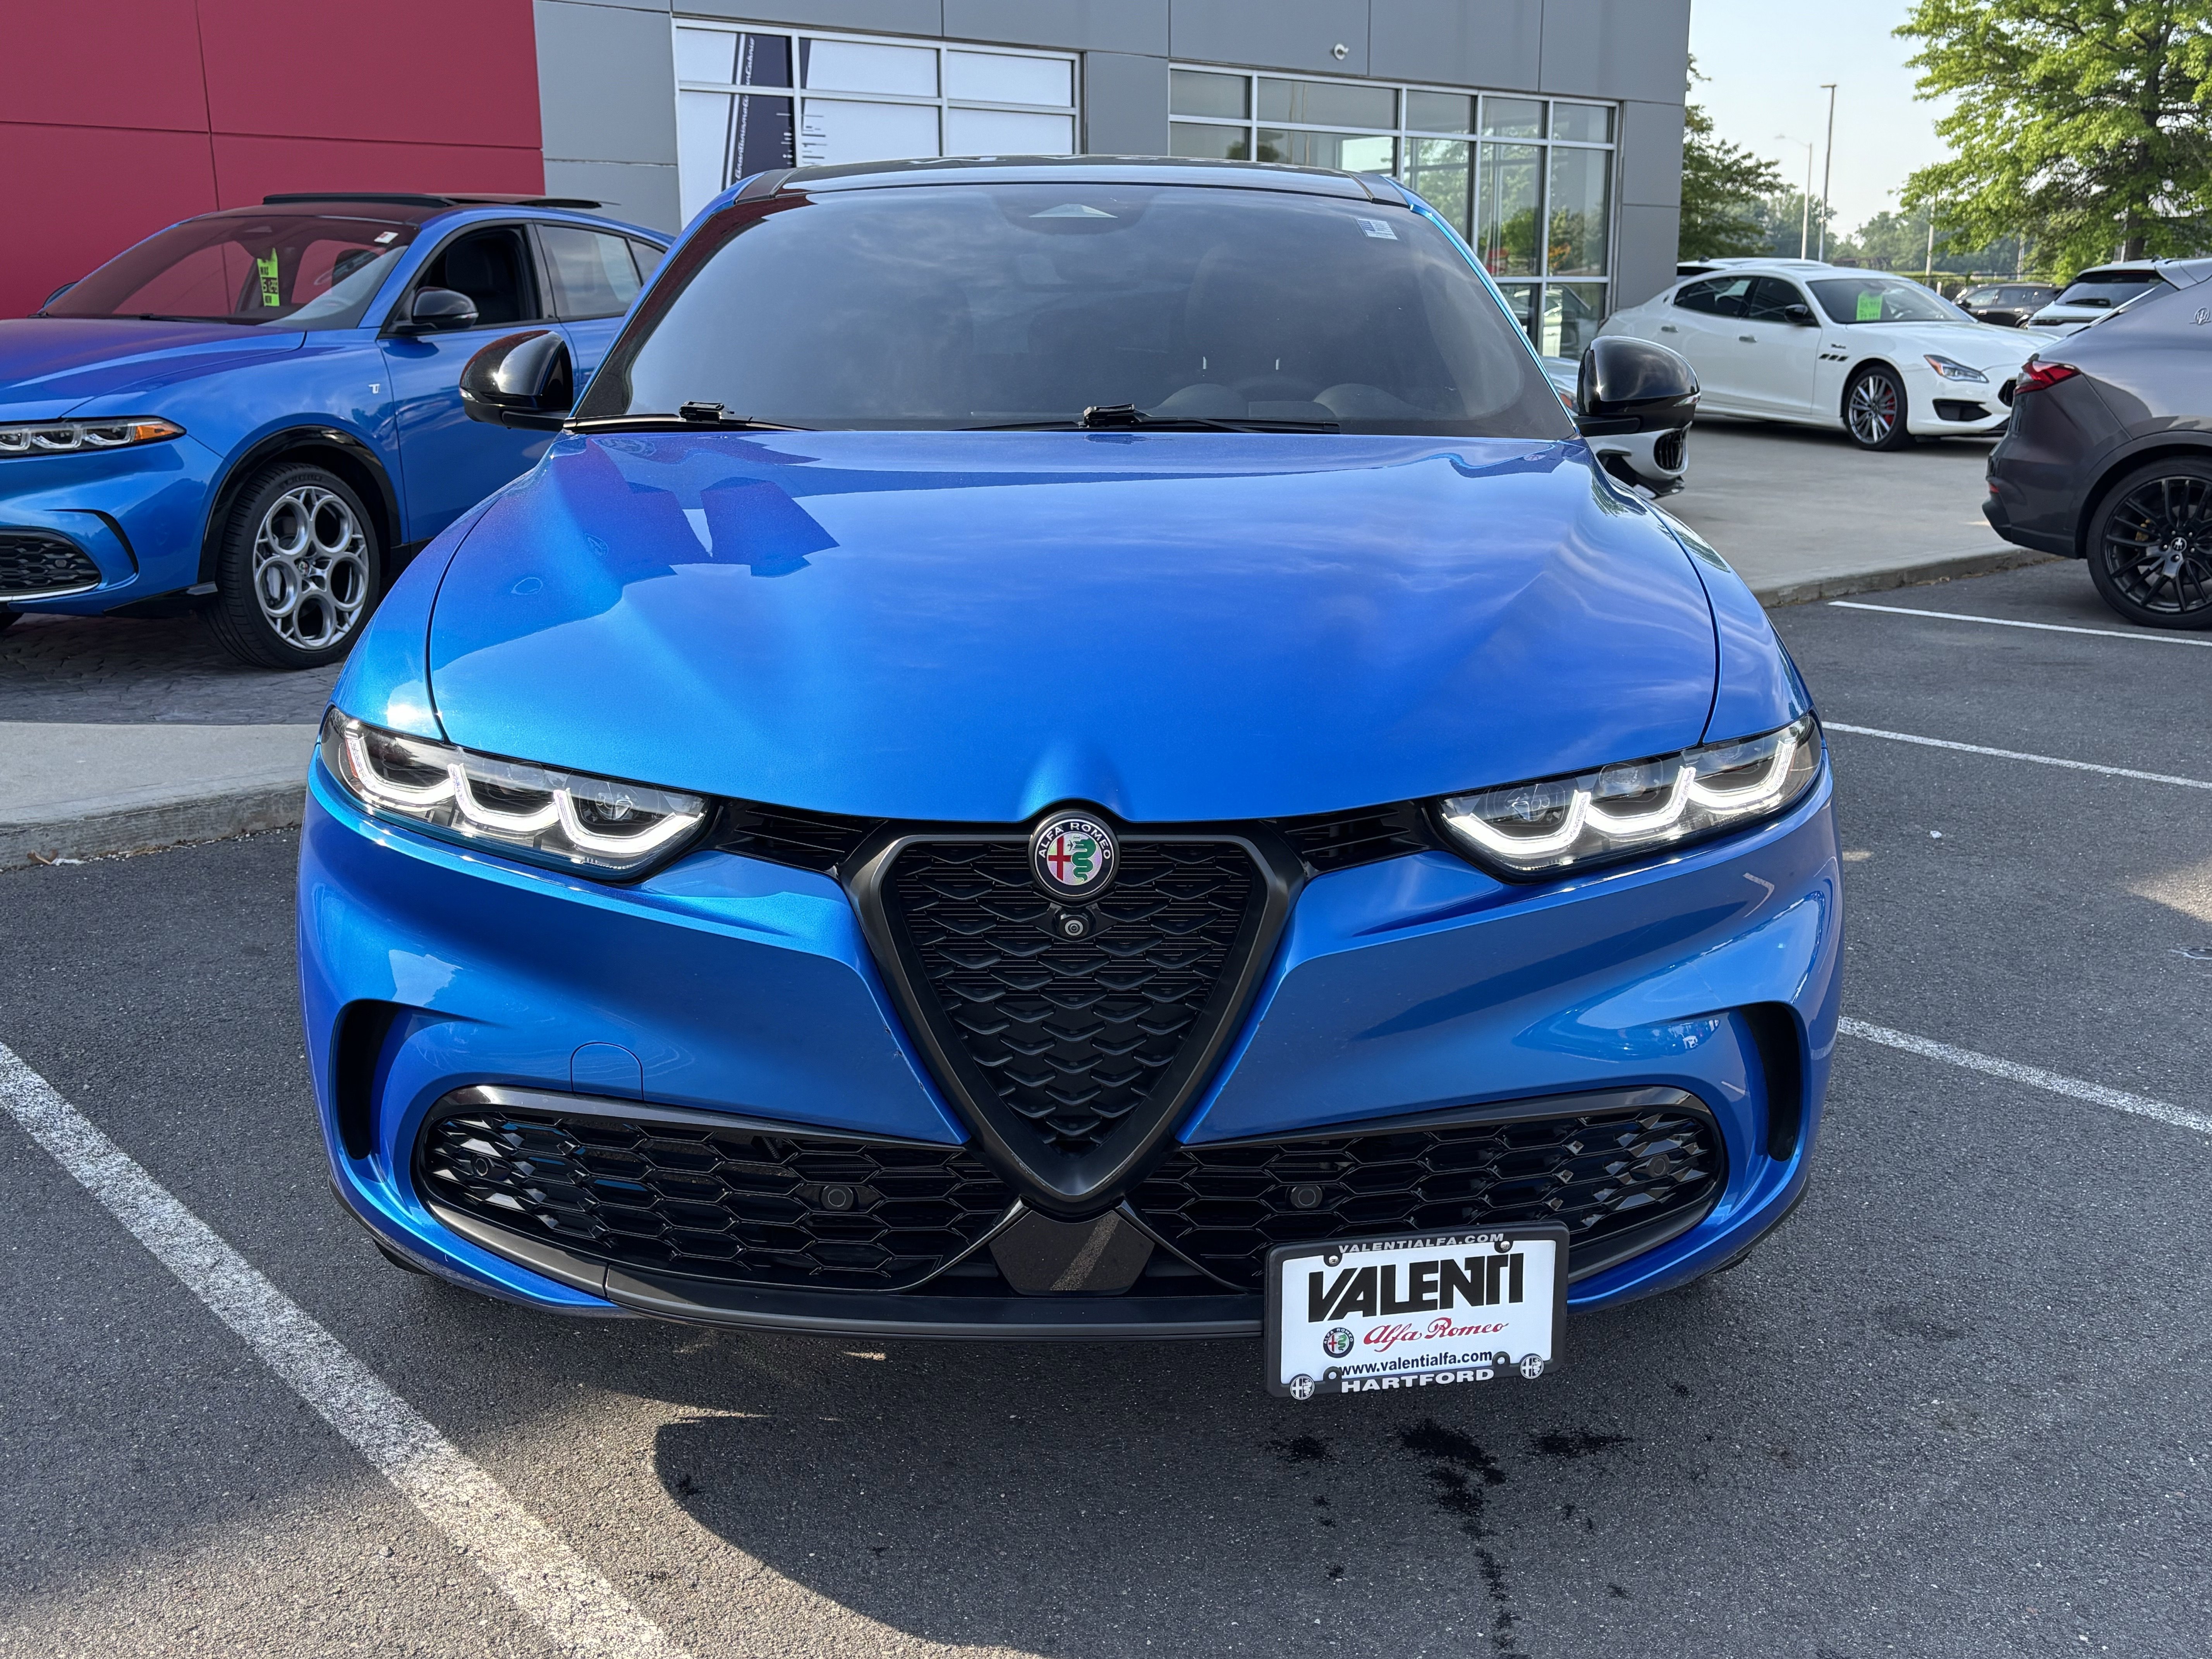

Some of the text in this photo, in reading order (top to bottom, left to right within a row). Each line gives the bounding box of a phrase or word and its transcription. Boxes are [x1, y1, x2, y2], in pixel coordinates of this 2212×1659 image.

[1039, 822, 1111, 859] ALFA ROMEO
[1338, 1233, 1504, 1254] VALENTIALFA.COM
[1308, 1253, 1524, 1323] VALENTI
[1336, 1328, 1353, 1342] ROMEO
[1363, 1317, 1509, 1352] Alfa Romeo
[1340, 1351, 1492, 1376] www.valentialfa.com
[1341, 1369, 1494, 1393] HARTFORD
